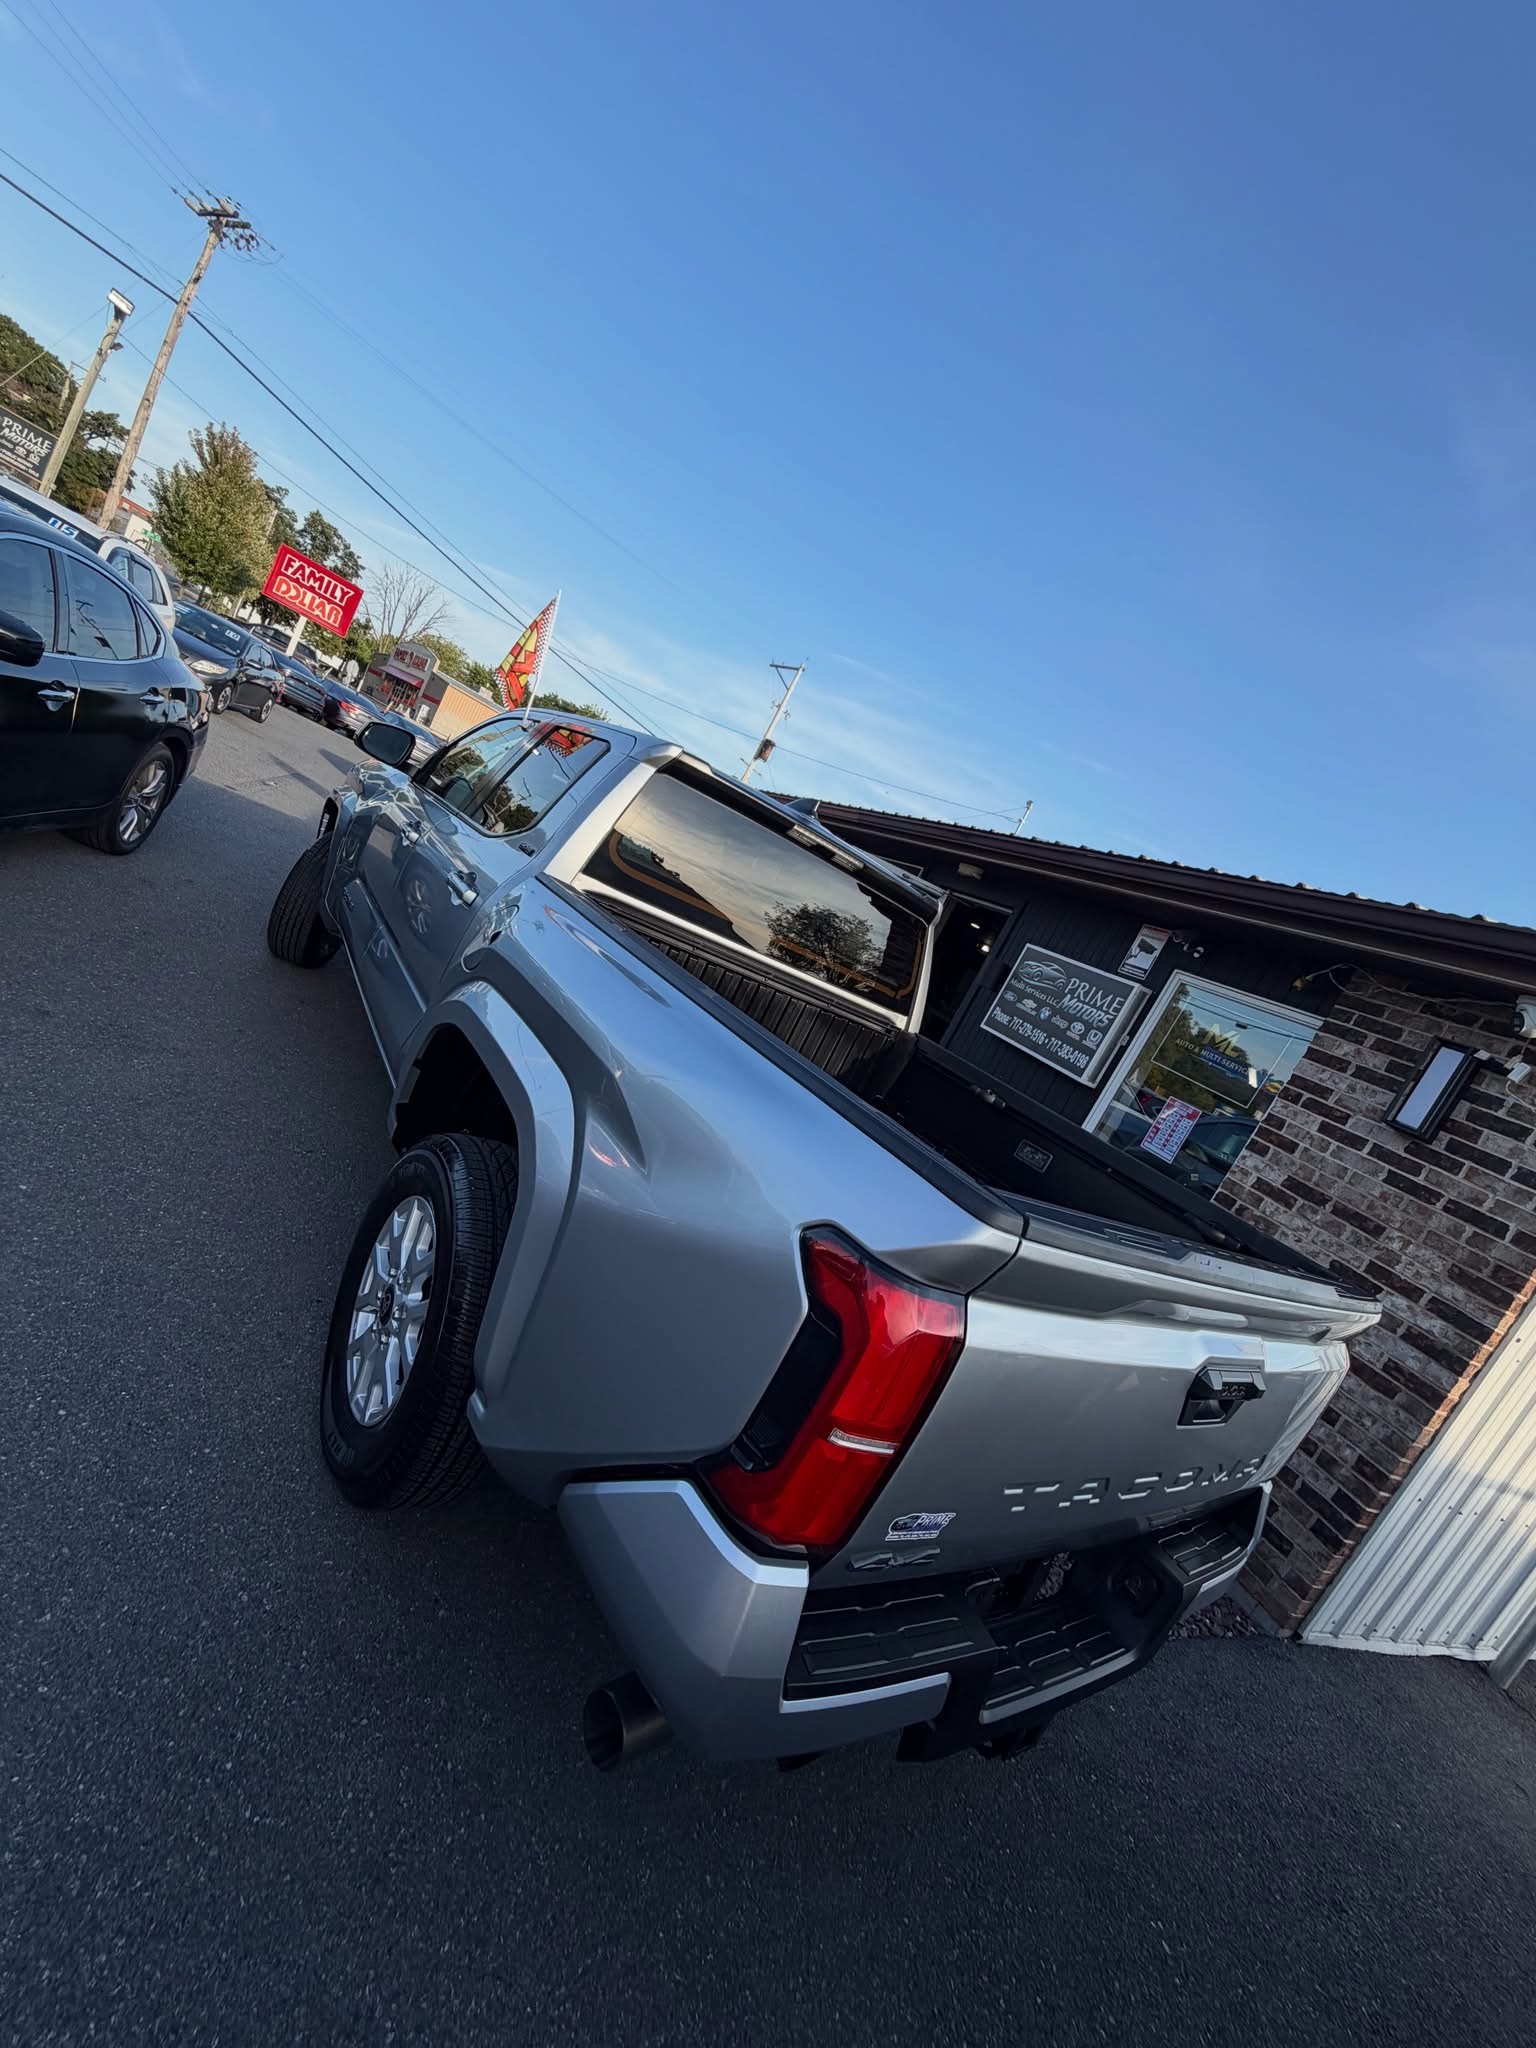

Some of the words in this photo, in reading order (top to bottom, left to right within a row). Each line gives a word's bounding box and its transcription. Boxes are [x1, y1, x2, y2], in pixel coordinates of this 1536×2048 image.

[0, 427, 49, 457] MOTORS
[2, 416, 53, 452] PRIME
[281, 554, 355, 606] FAMILY
[272, 575, 343, 627] DOLLAR
[1024, 985, 1047, 1000] Services
[1046, 995, 1058, 1007] LLC
[1056, 995, 1115, 1028] MOTORS
[1065, 978, 1125, 1016] PRIME
[992, 1006, 1012, 1025] Phone:
[1176, 1039, 1194, 1050] AUTO
[1200, 1048, 1222, 1064] MULTI
[1003, 1454, 1267, 1511] TACOMA
